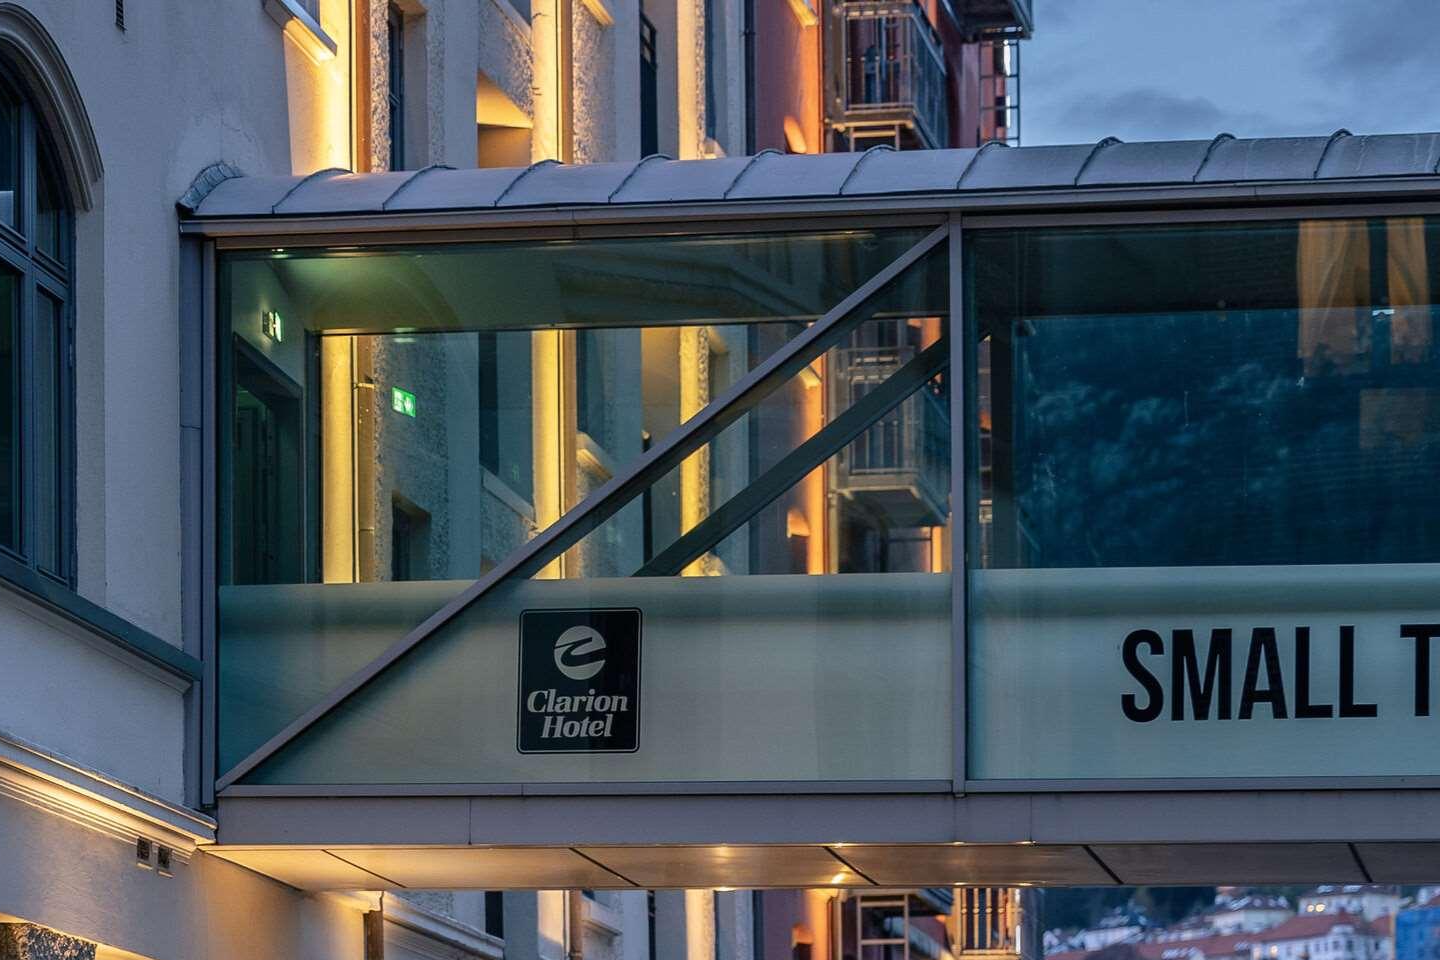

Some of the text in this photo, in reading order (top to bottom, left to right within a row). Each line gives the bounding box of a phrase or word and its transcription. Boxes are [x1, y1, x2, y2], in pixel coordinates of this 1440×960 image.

[1121, 626, 1378, 723] SMALL
[527, 688, 629, 713] Clarion
[541, 713, 612, 738] Hotel
